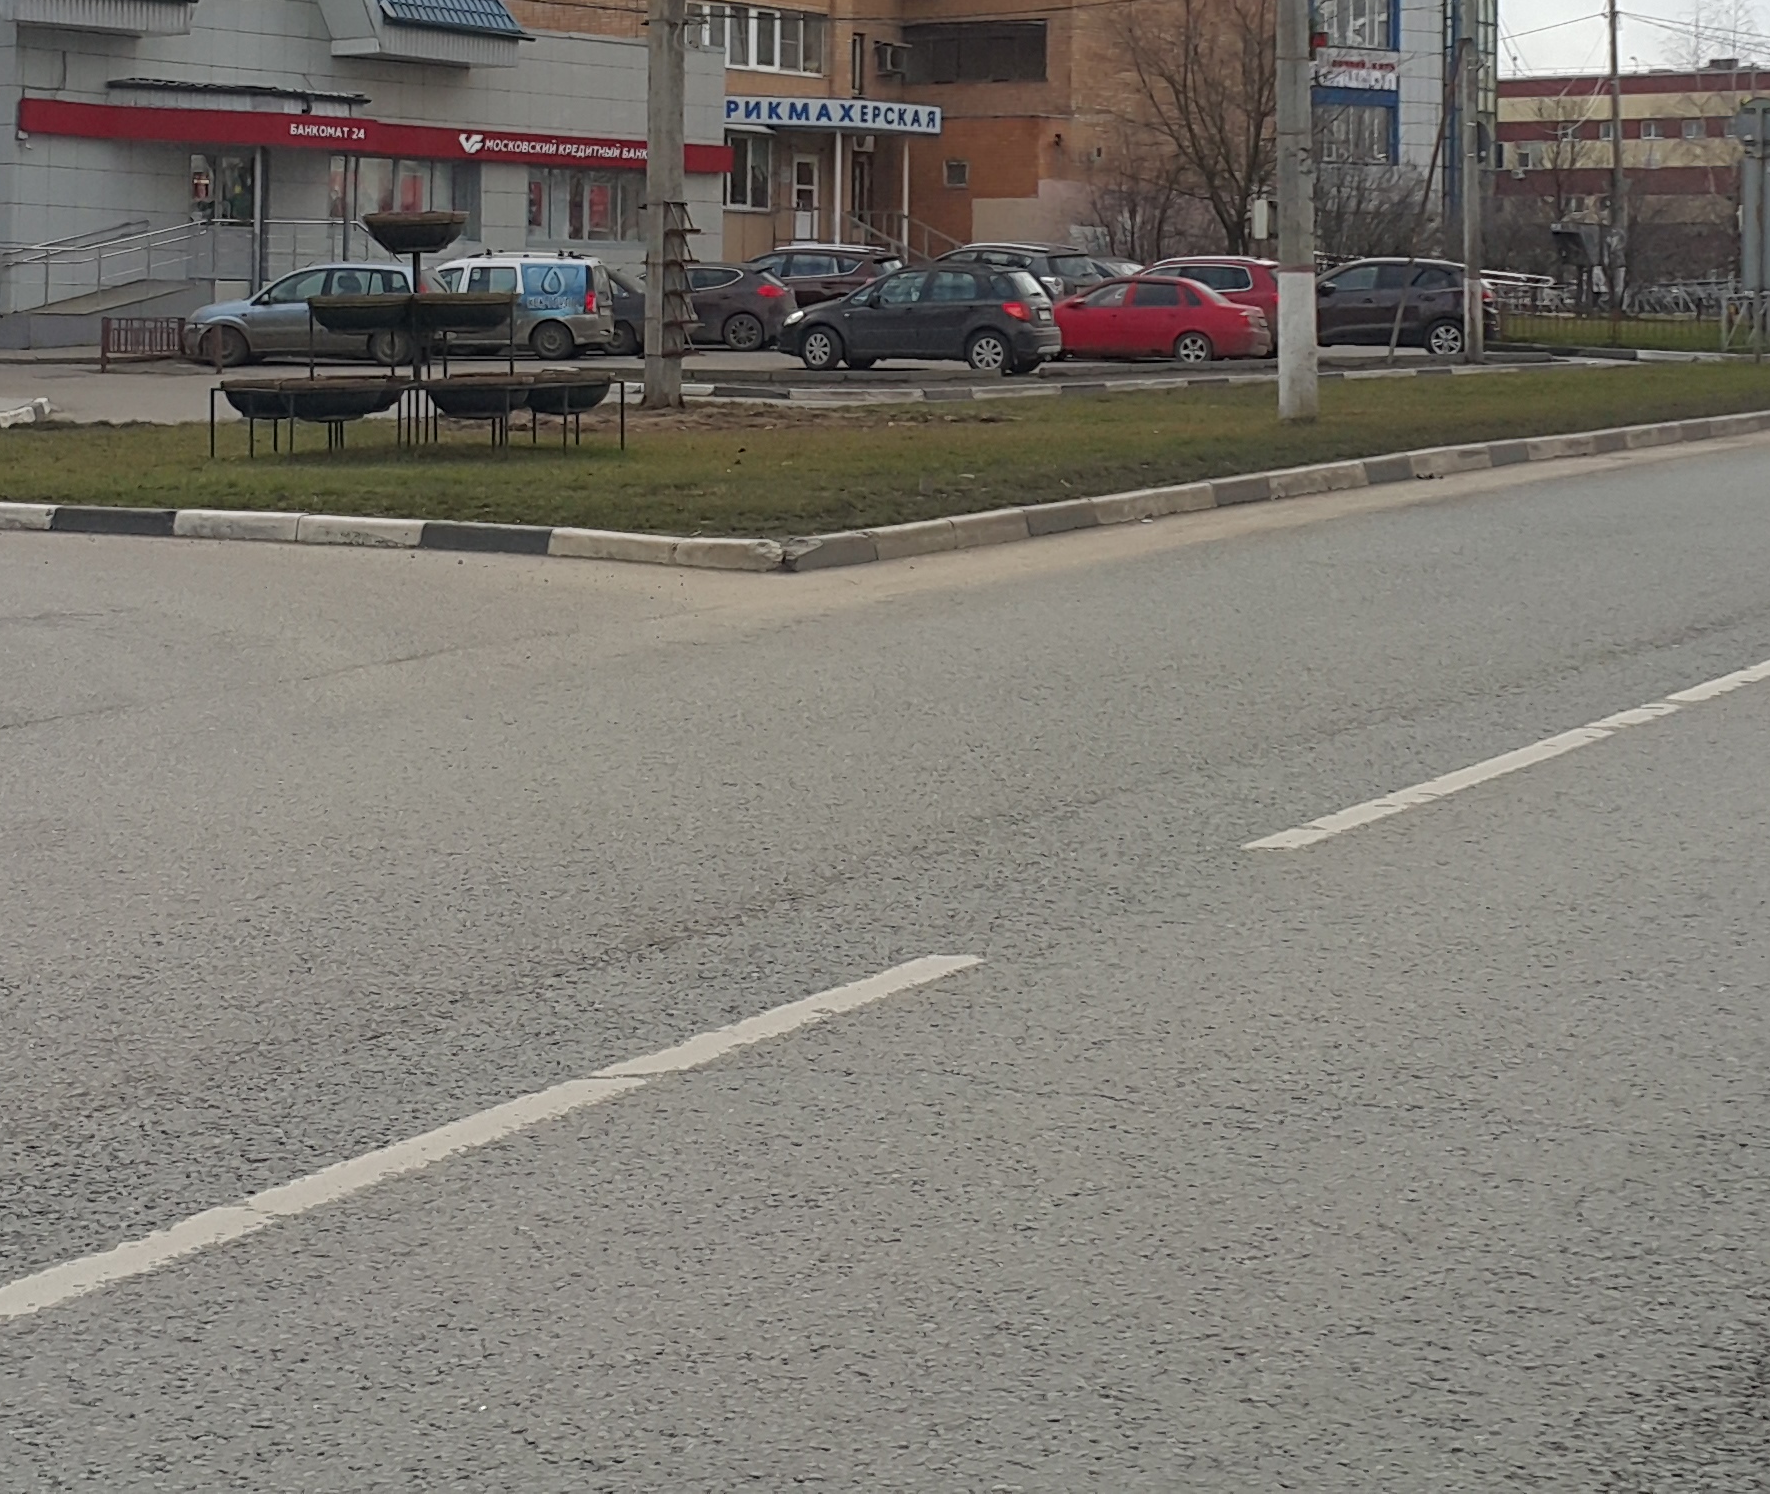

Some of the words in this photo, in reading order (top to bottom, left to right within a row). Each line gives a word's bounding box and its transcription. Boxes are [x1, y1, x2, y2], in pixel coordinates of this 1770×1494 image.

[725, 99, 937, 129] РИКМАХЕРСКАЯ
[290, 123, 349, 138] БАНКОМАТ
[351, 127, 365, 140] 24
[484, 139, 557, 155] МОСКОВСКИЙ
[558, 143, 621, 159] КРЕДИТНЫЙ
[622, 148, 648, 159] БАНК
